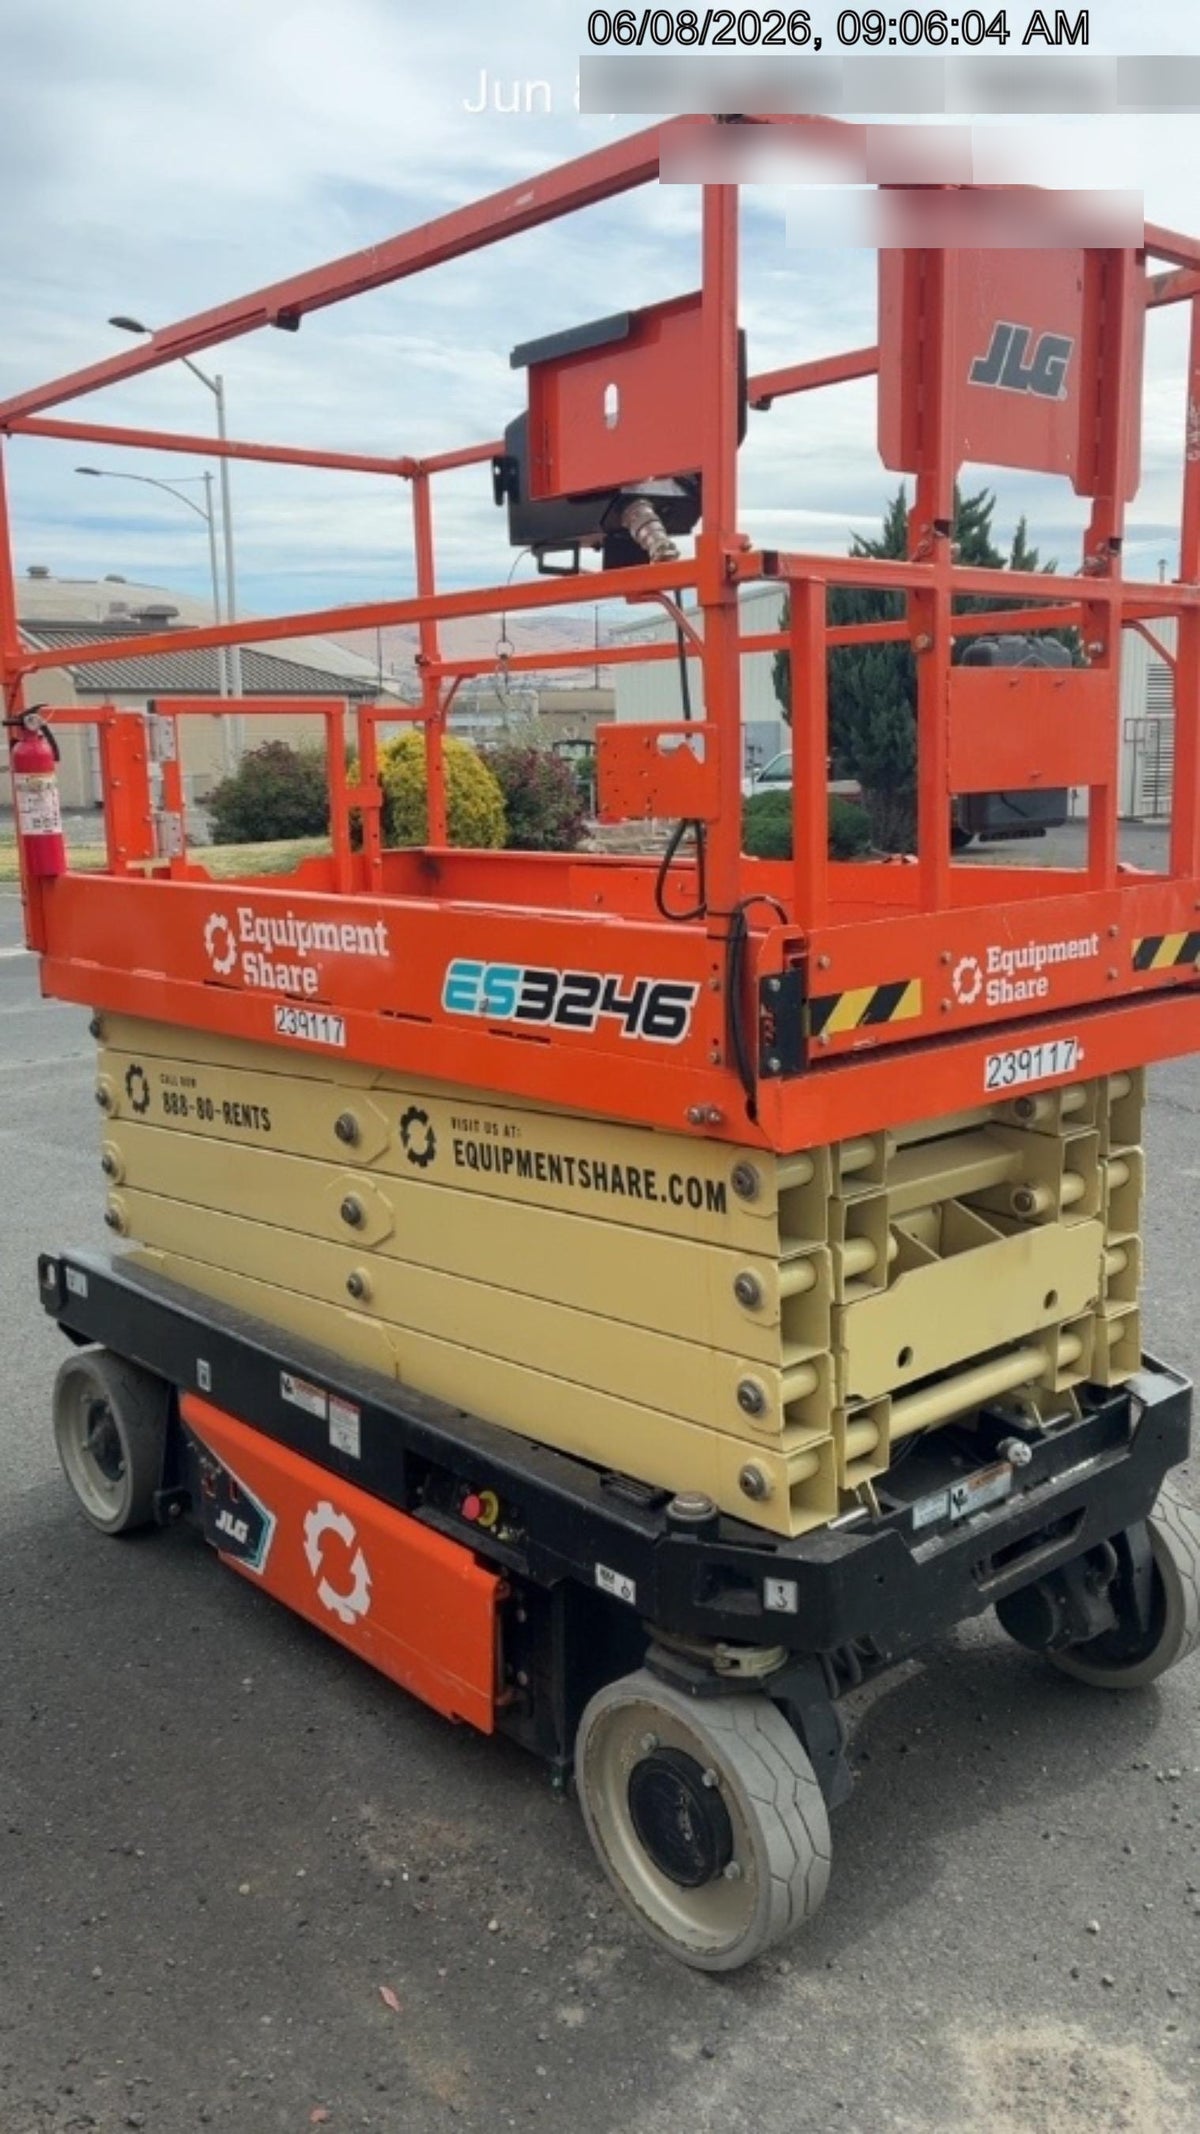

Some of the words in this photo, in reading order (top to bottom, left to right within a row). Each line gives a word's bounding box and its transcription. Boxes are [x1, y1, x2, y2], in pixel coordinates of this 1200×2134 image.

[967, 320, 1075, 401] JLG
[237, 907, 390, 957] Equipment
[986, 932, 1099, 976] Equipment
[241, 951, 319, 994] Share
[985, 976, 1049, 1006] Share
[441, 958, 700, 1044] ES3246
[276, 1007, 344, 1044] 239117
[987, 1039, 1076, 1088] 239117
[451, 1116, 480, 1133] VISIT
[483, 1120, 499, 1136] US
[453, 1138, 728, 1214] EQUIPMENTSHARE.COM
[215, 1510, 249, 1544] JLG
